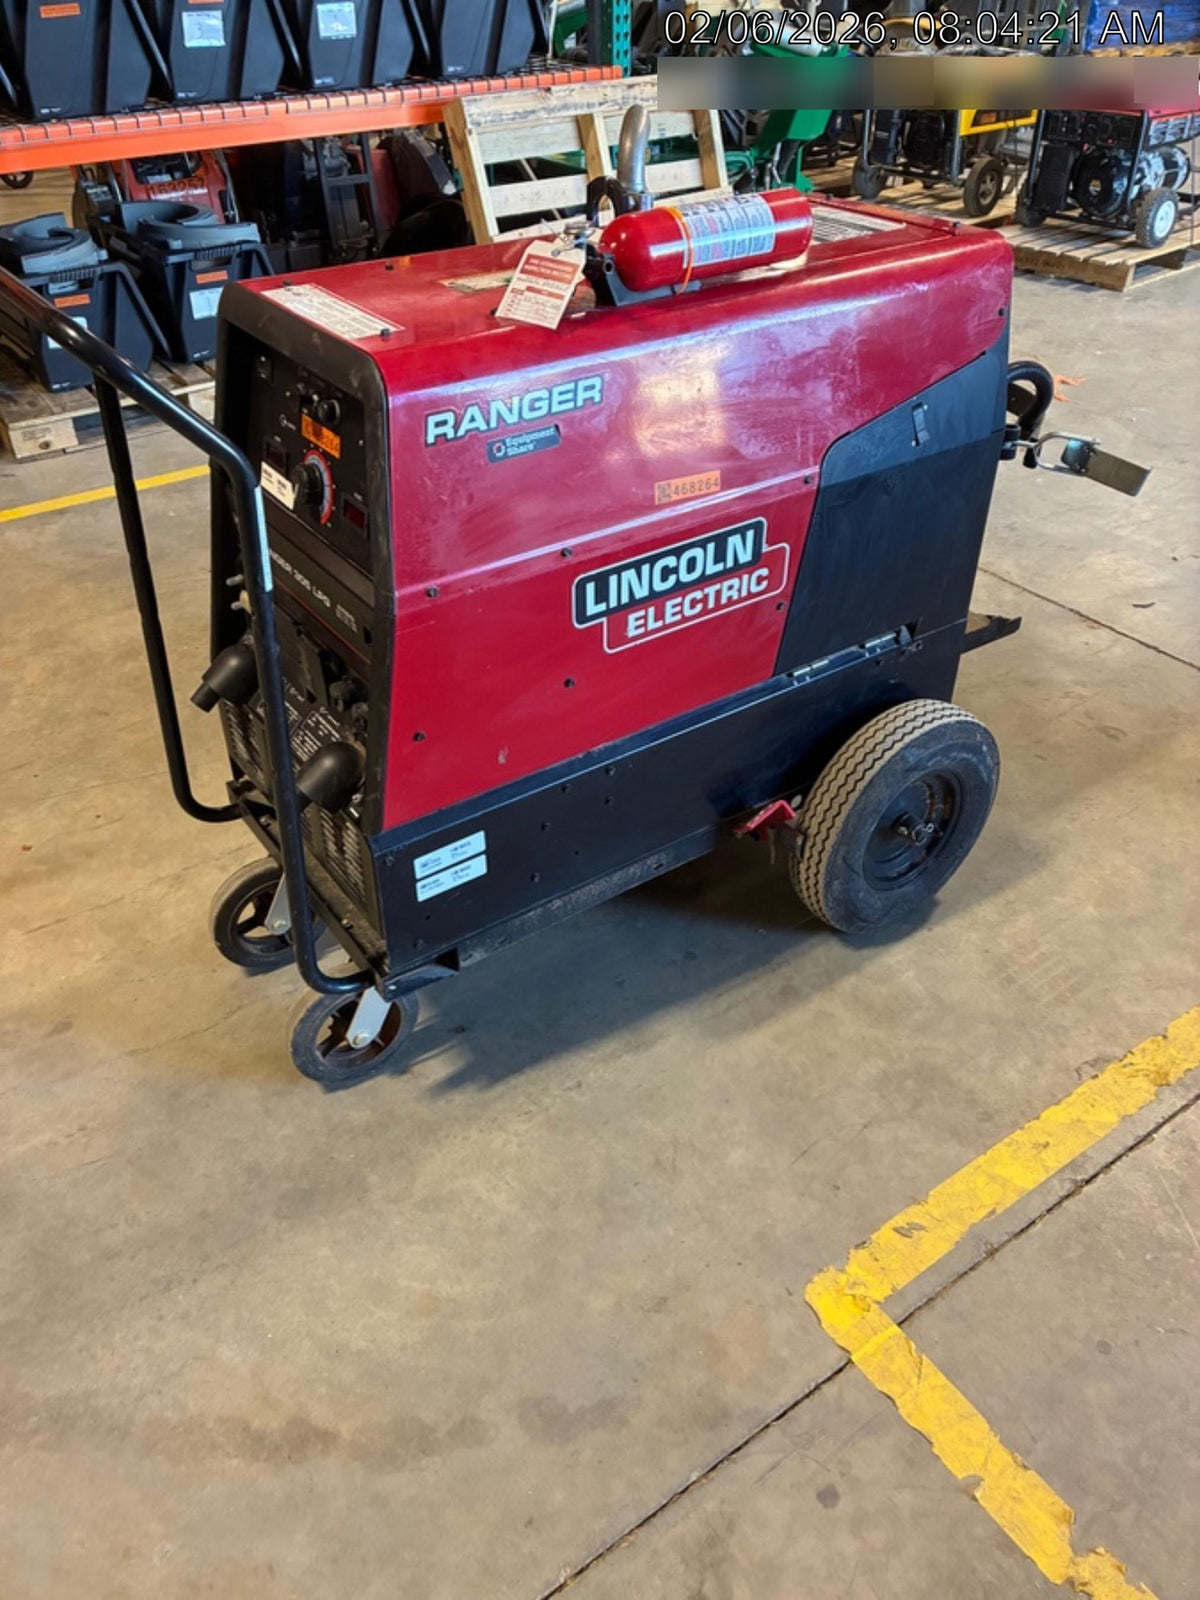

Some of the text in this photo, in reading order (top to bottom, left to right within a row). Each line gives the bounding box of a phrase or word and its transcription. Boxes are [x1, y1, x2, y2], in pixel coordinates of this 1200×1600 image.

[426, 375, 603, 445] RANGER
[674, 477, 719, 496] 468264
[586, 529, 755, 617] LINCOLN
[626, 568, 769, 638] ELECTRIC
